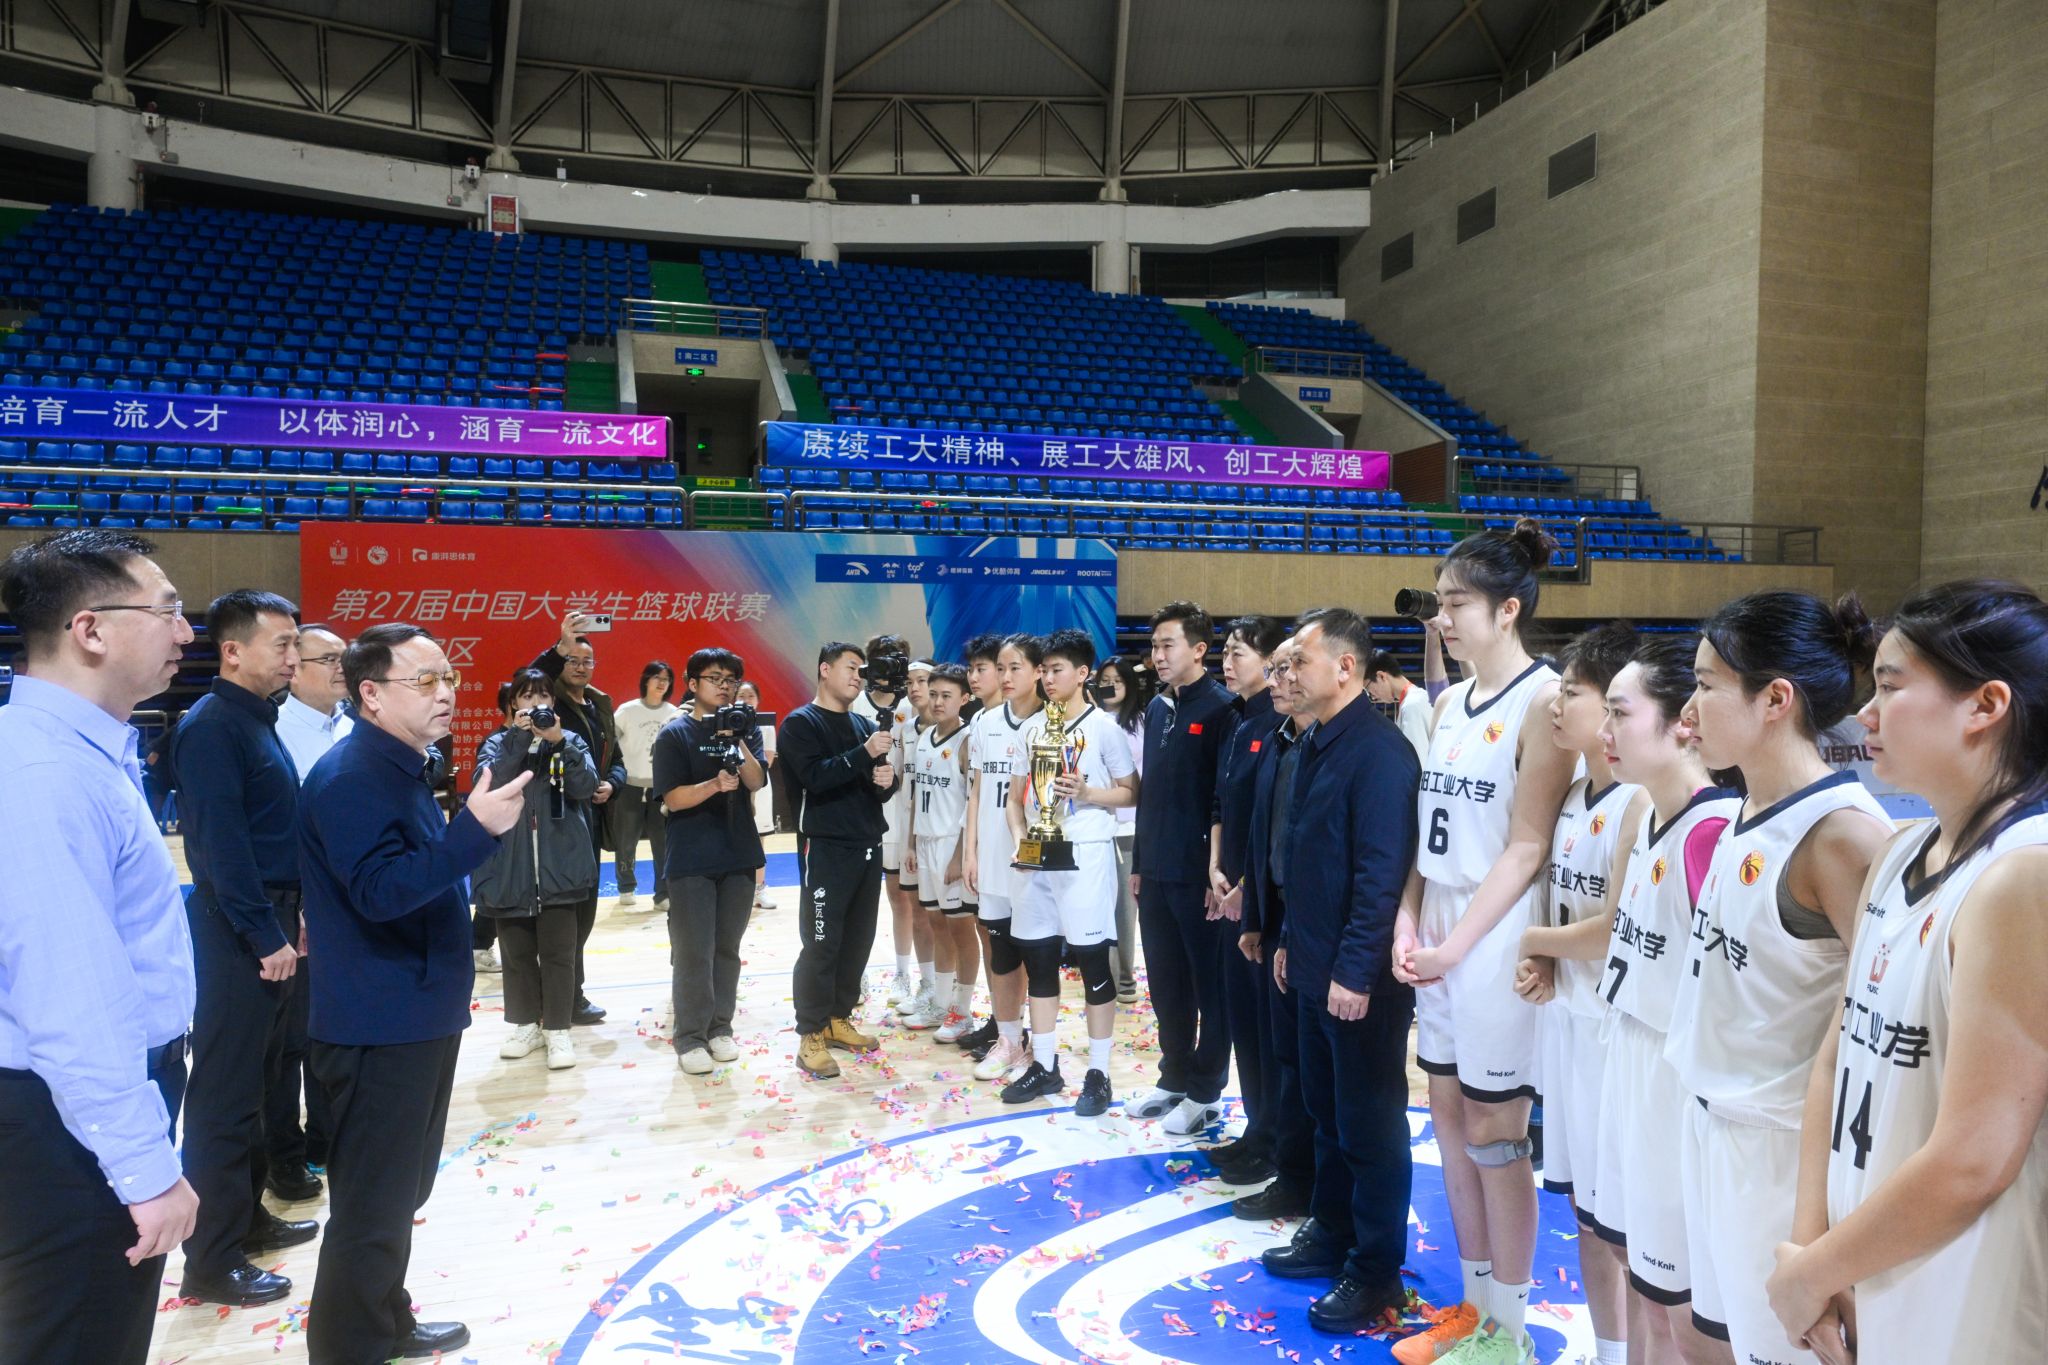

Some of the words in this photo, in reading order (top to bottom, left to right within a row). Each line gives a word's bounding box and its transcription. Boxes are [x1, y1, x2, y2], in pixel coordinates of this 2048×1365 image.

[0, 395, 228, 432] 培育一流人才
[278, 407, 658, 447] 以体润心，涵育一流文化
[800, 428, 1365, 480] 赓续工大精神、展工大雄风、创工大辉煌
[327, 588, 772, 622] 第27届中国大学生篮球联赛
[1427, 807, 1449, 856] 6
[1832, 1066, 1873, 1170] 14
